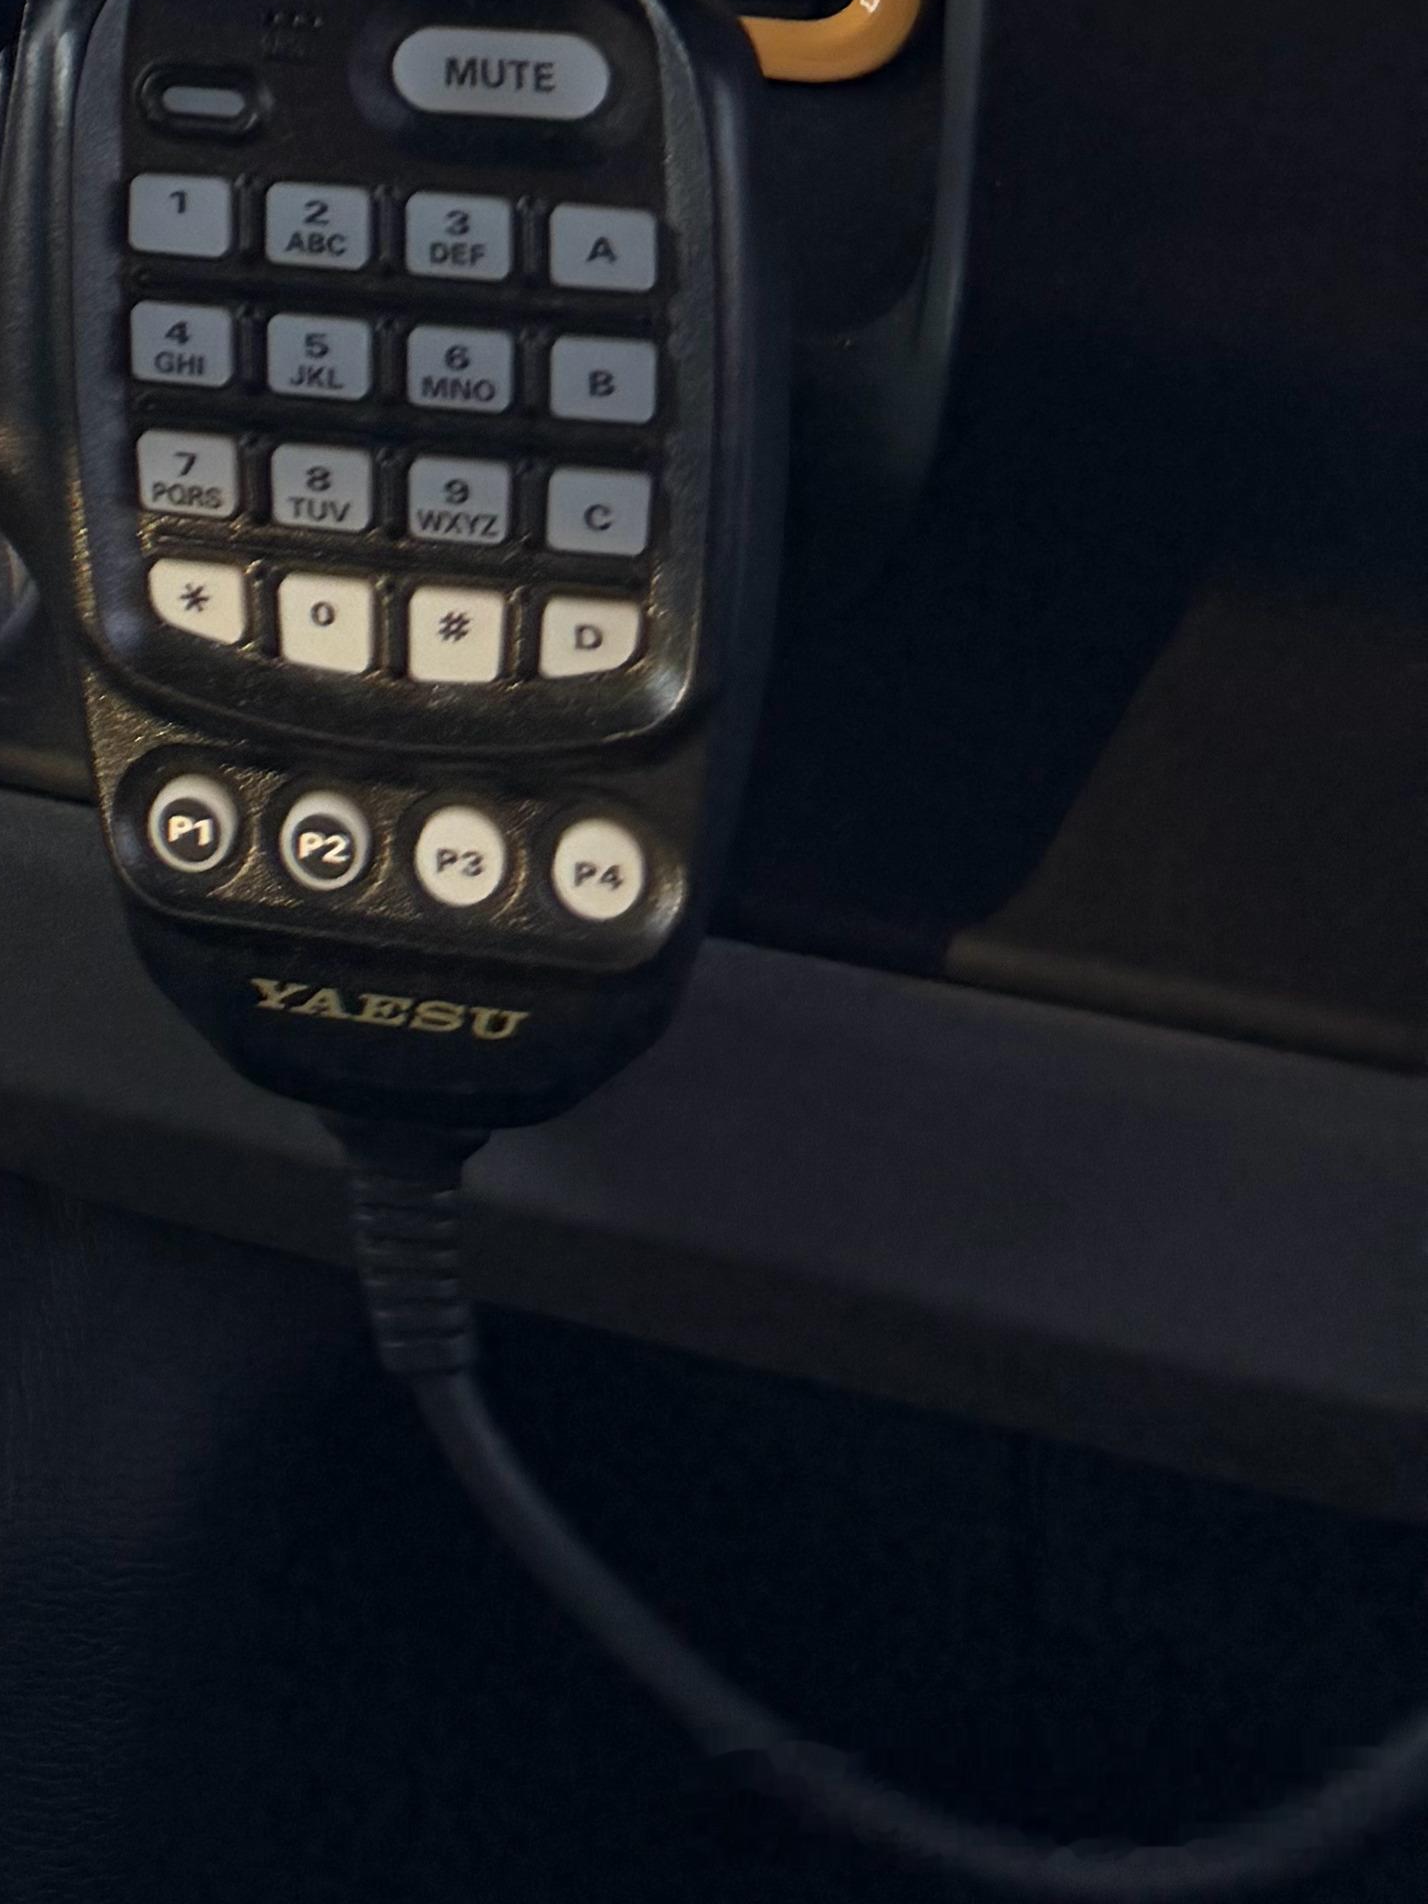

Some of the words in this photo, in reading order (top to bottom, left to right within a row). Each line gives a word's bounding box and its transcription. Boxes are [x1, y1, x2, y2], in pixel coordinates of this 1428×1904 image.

[444, 55, 556, 94] MUTE
[303, 200, 331, 224] 2
[446, 210, 471, 236] 3
[286, 230, 347, 258] ABC
[429, 241, 487, 268] DEF
[585, 238, 618, 265] A
[164, 320, 189, 347] 4
[304, 332, 330, 360] 5
[154, 350, 206, 378] GHI
[444, 344, 471, 371] 6
[289, 364, 343, 391] JKL
[421, 375, 497, 403] MNO
[587, 369, 615, 397] B
[172, 451, 200, 478] 7
[304, 465, 333, 491] 8
[152, 482, 224, 510] PQRS
[444, 478, 471, 504] 9
[288, 496, 351, 523] TUV
[417, 508, 499, 537] WXYZ
[585, 503, 613, 532] C
[437, 610, 471, 643] #
[574, 623, 603, 652] D
[166, 815, 214, 847] P1
[297, 830, 350, 864] P2
[435, 847, 484, 878] P3
[573, 861, 624, 891] P4
[250, 977, 531, 1041] YAESU
